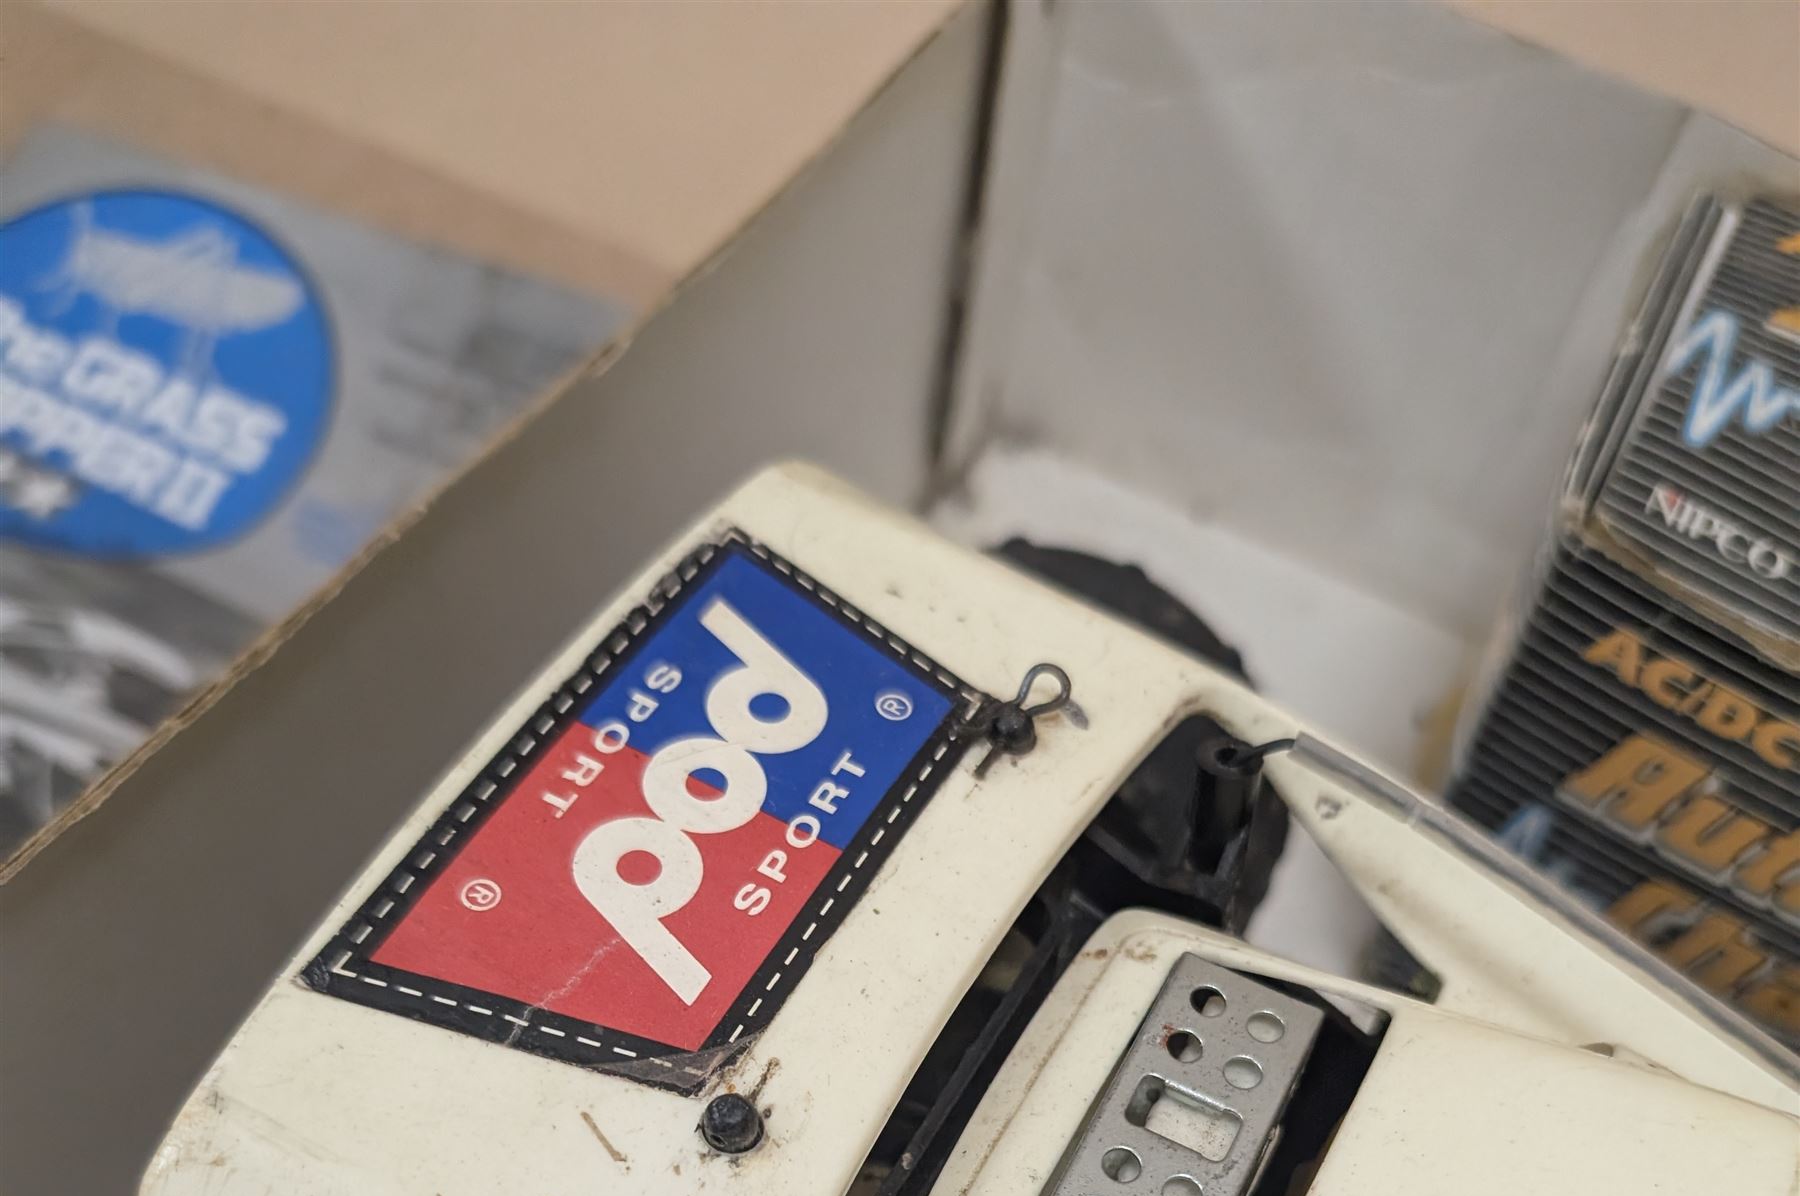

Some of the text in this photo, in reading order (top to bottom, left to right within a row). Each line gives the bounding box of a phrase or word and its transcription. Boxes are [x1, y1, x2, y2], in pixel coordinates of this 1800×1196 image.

[1644, 484, 1792, 580] NIPCO
[541, 663, 682, 819] SPORT
[733, 750, 867, 917] SPORT
